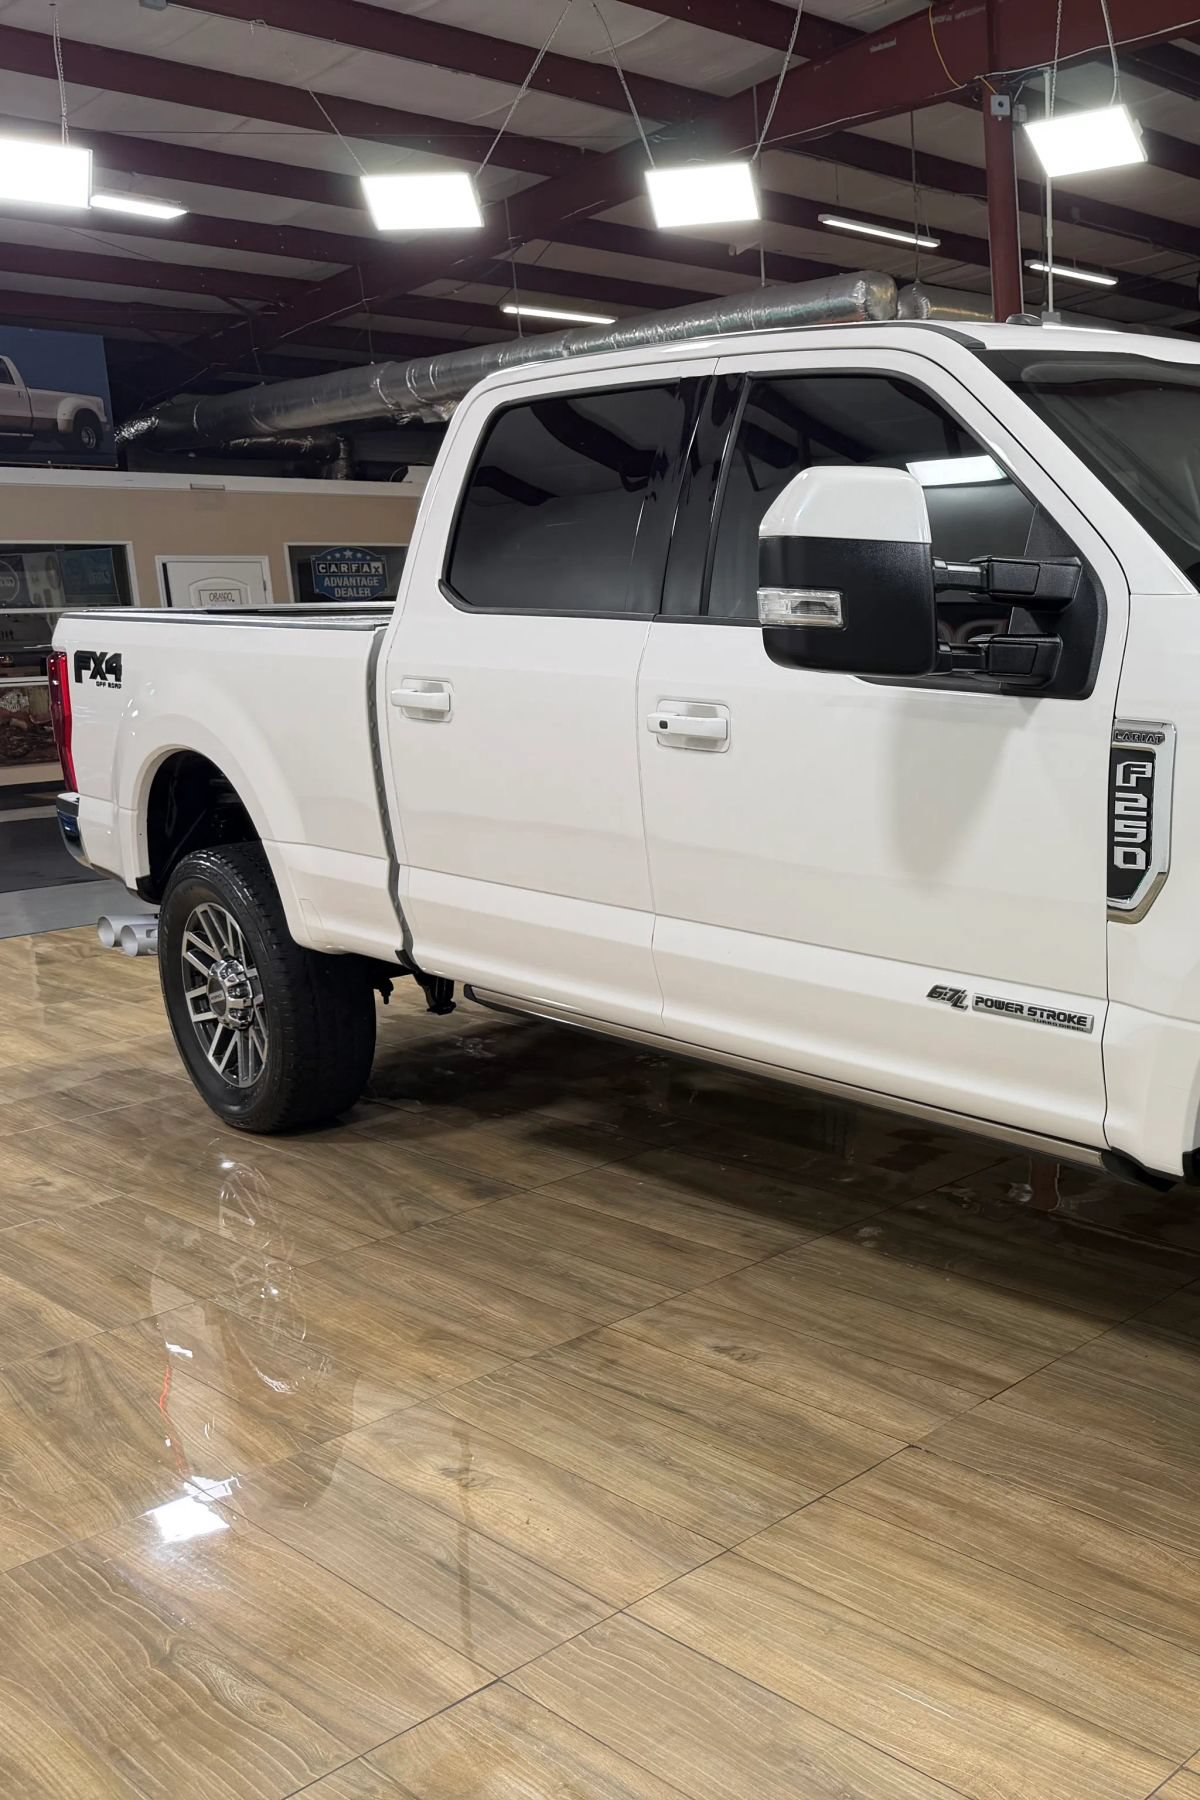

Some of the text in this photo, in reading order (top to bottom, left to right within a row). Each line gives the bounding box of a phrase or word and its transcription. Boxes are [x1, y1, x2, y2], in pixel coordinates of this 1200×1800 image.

[318, 563, 383, 575] CARFAX
[323, 576, 380, 587] ADVANTAGE
[335, 587, 371, 598] DEALER
[74, 650, 122, 683] FX4
[96, 680, 106, 688] OFF
[1115, 731, 1163, 744] LARIAT
[974, 996, 1087, 1027] POWER STROKE
